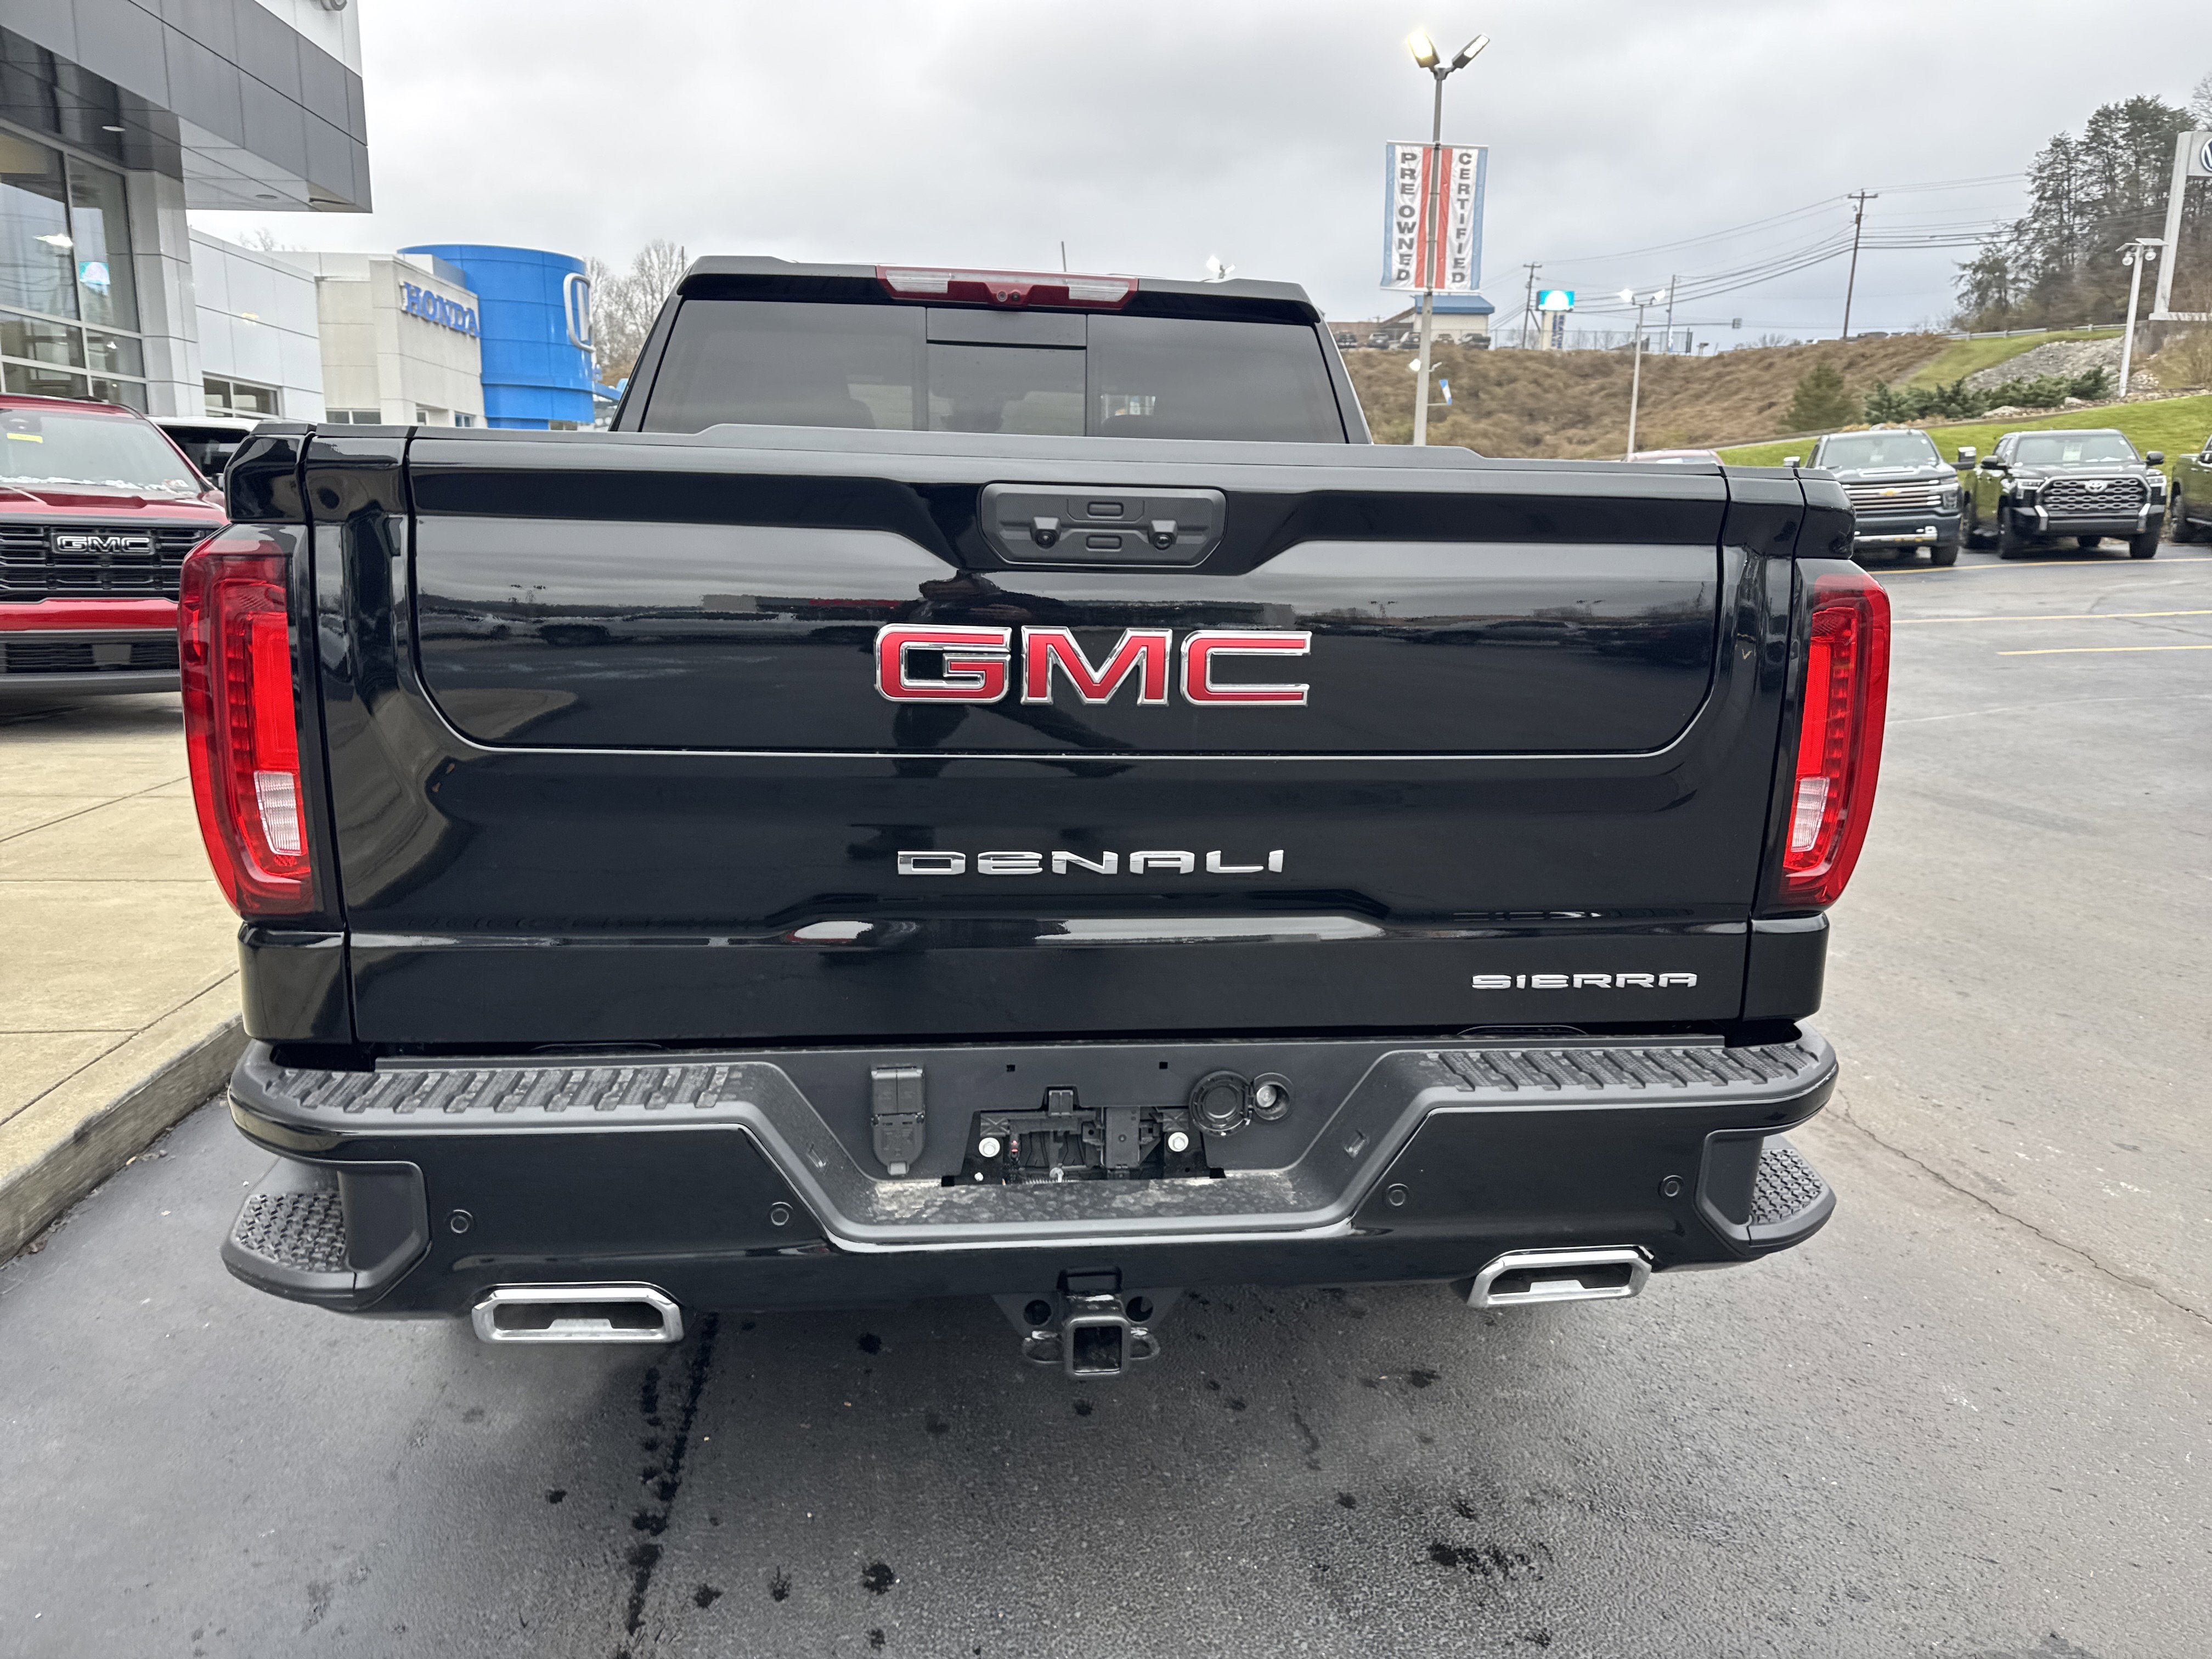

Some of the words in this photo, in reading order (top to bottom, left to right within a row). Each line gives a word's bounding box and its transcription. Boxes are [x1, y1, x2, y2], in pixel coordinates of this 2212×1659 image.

[1400, 152, 1417, 195] PRE
[1396, 205, 1417, 281] OWNED
[1451, 153, 1472, 283] CERTIFIED
[402, 280, 480, 337] HONDA
[57, 535, 150, 553] GMC
[875, 623, 1312, 707] GMC
[897, 849, 1284, 875] DENALI
[1472, 973, 1698, 989] SIERRA
